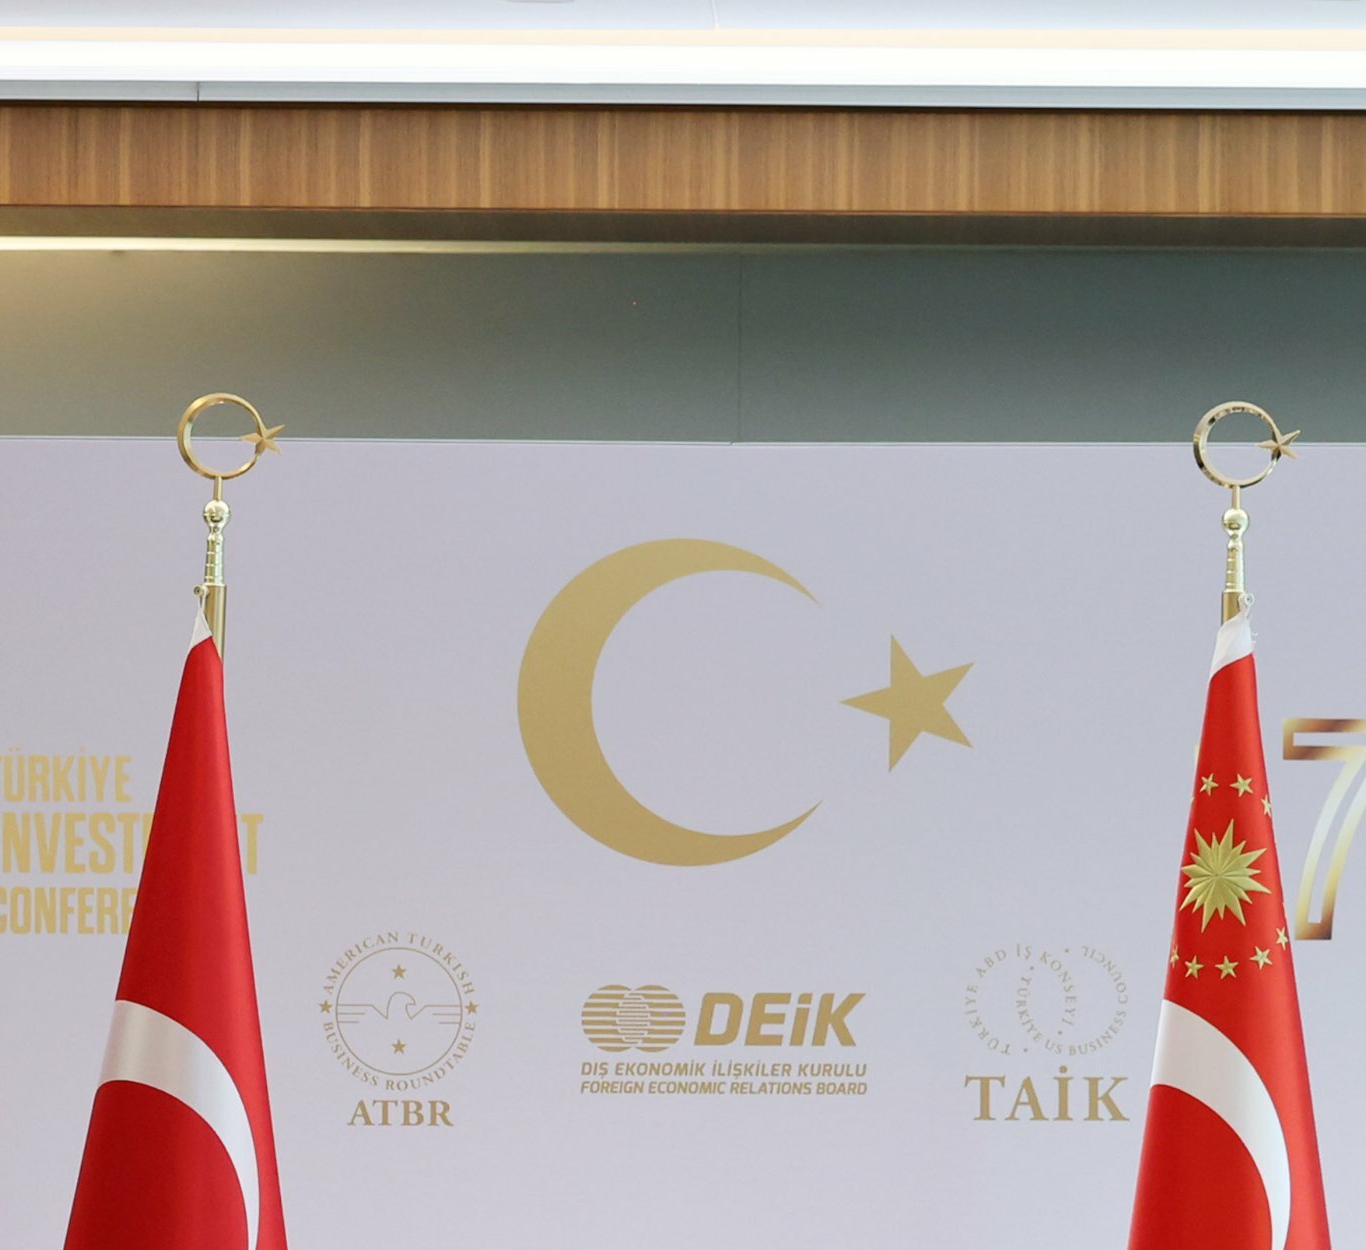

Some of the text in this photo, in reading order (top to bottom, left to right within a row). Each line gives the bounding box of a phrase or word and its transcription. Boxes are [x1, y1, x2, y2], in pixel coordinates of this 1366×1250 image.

[323, 932, 476, 995] AMERICAN TURKISH
[975, 949, 1007, 978] ABD
[1082, 945, 1129, 1004] COUNCIL
[1044, 1039, 1062, 1055] US
[1069, 1010, 1127, 1056] BUSINESS
[323, 1022, 476, 1091] BUSINESS ROUNDTABLE
[580, 1059, 867, 1079] DIŞ EKONOMİK İLİŞKİLER KURULU
[580, 1080, 868, 1096] FOREIGN ECONOMIC RELATIONS BOARD
[965, 1066, 1129, 1121] TAİK
[348, 1100, 453, 1126] ATBR
